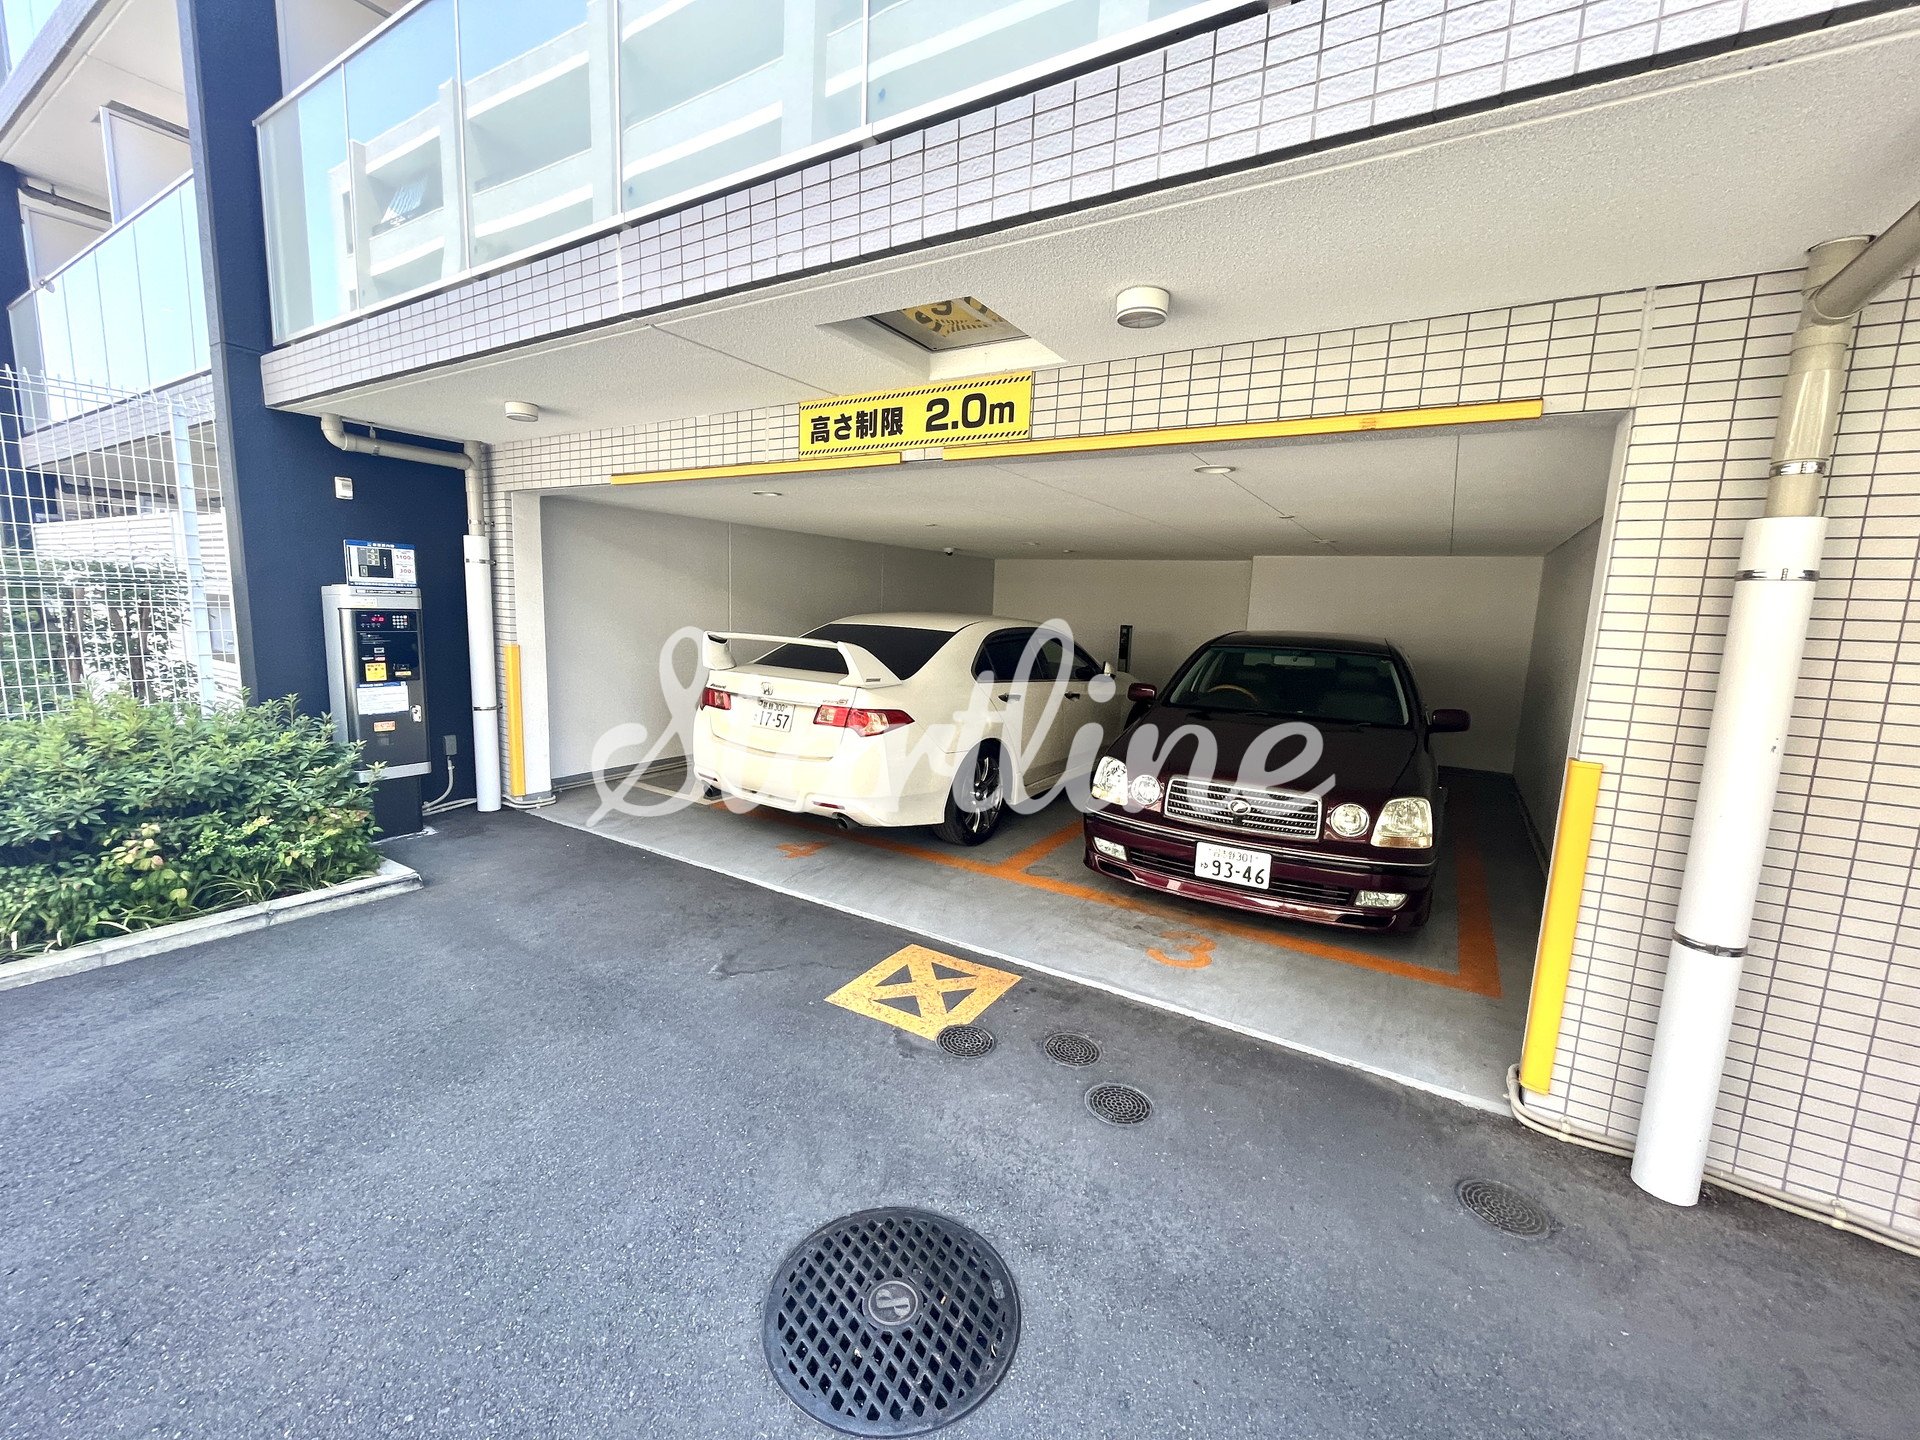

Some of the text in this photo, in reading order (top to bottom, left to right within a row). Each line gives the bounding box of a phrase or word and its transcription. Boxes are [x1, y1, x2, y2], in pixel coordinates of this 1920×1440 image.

[810, 392, 1015, 445] 高さ制限 2.0m
[1211, 859, 1265, 885] 93-46
[1236, 851, 1253, 863] 301
[1145, 929, 1217, 970] 3
